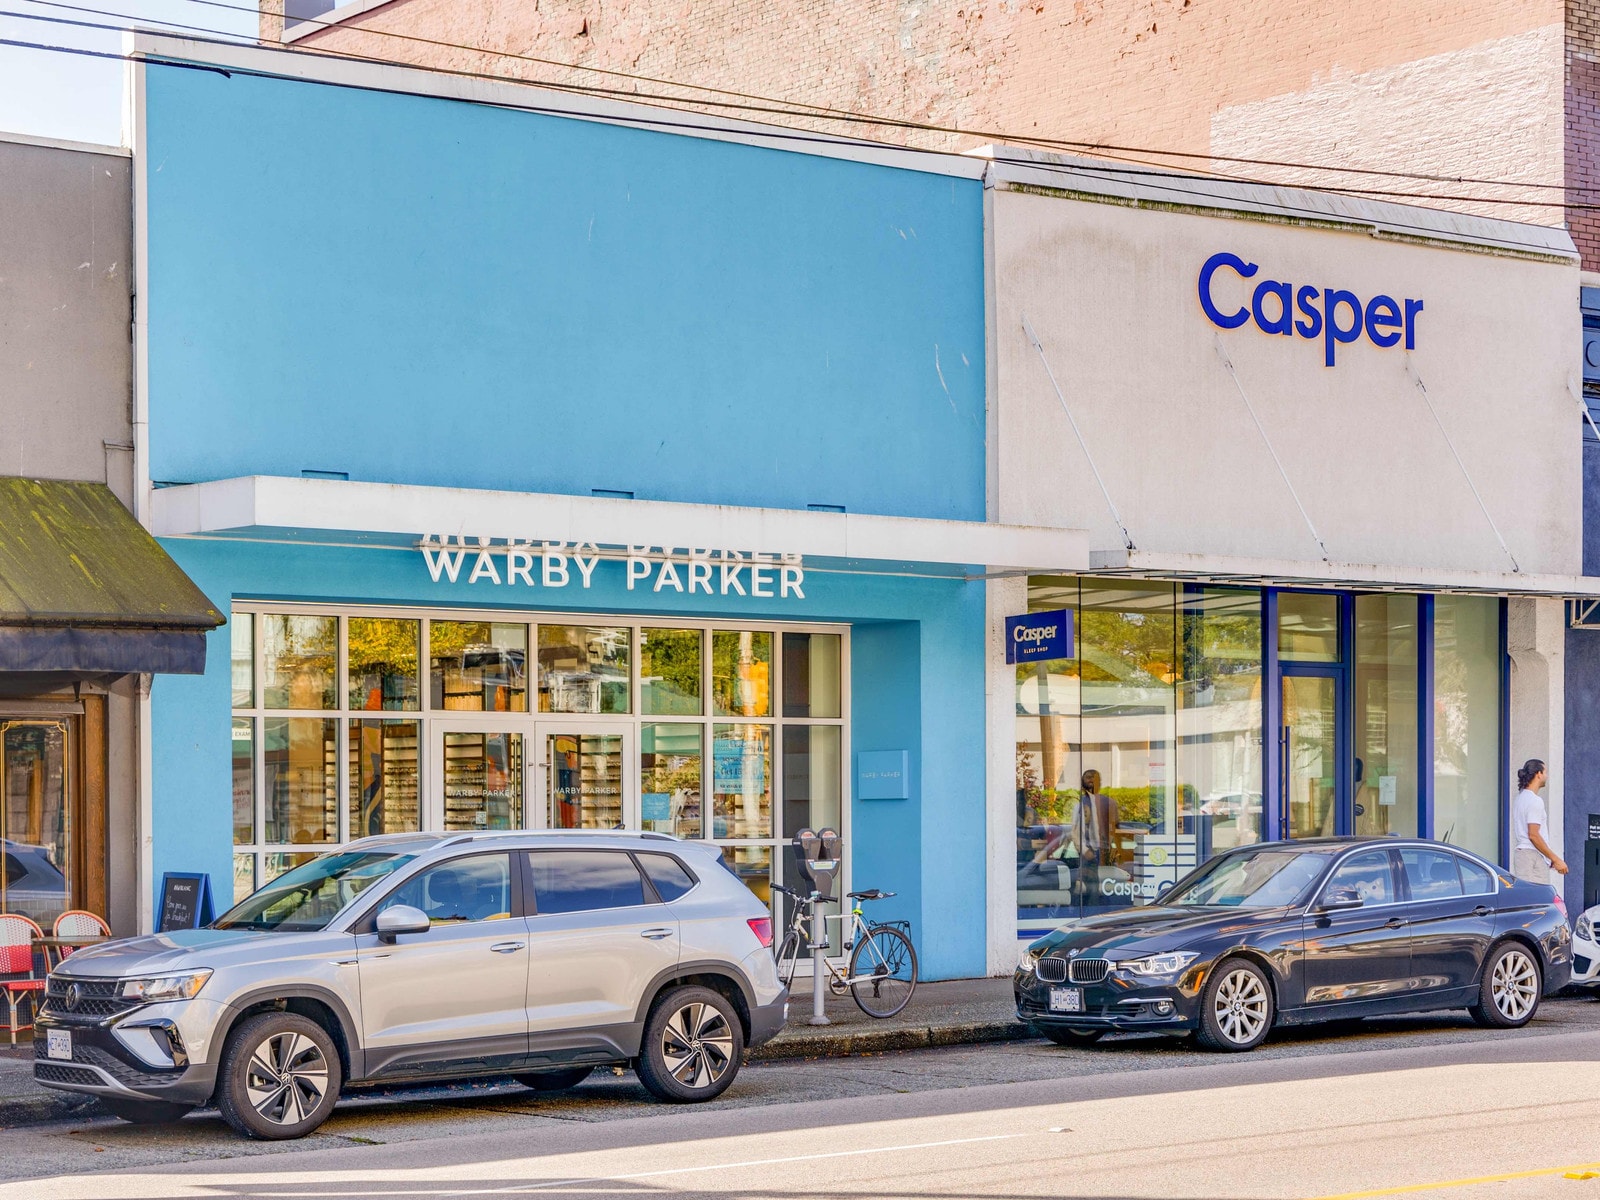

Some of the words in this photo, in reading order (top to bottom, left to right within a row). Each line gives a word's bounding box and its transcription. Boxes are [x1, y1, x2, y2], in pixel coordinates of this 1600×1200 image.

[1198, 252, 1424, 367] Casper
[421, 547, 599, 589] WARBY
[626, 556, 806, 599] PARKER
[1013, 625, 1057, 646] Casper
[449, 789, 479, 797] WARBY
[482, 789, 515, 797] PARKER
[554, 787, 581, 795] WARBY
[585, 787, 617, 795] PARKER
